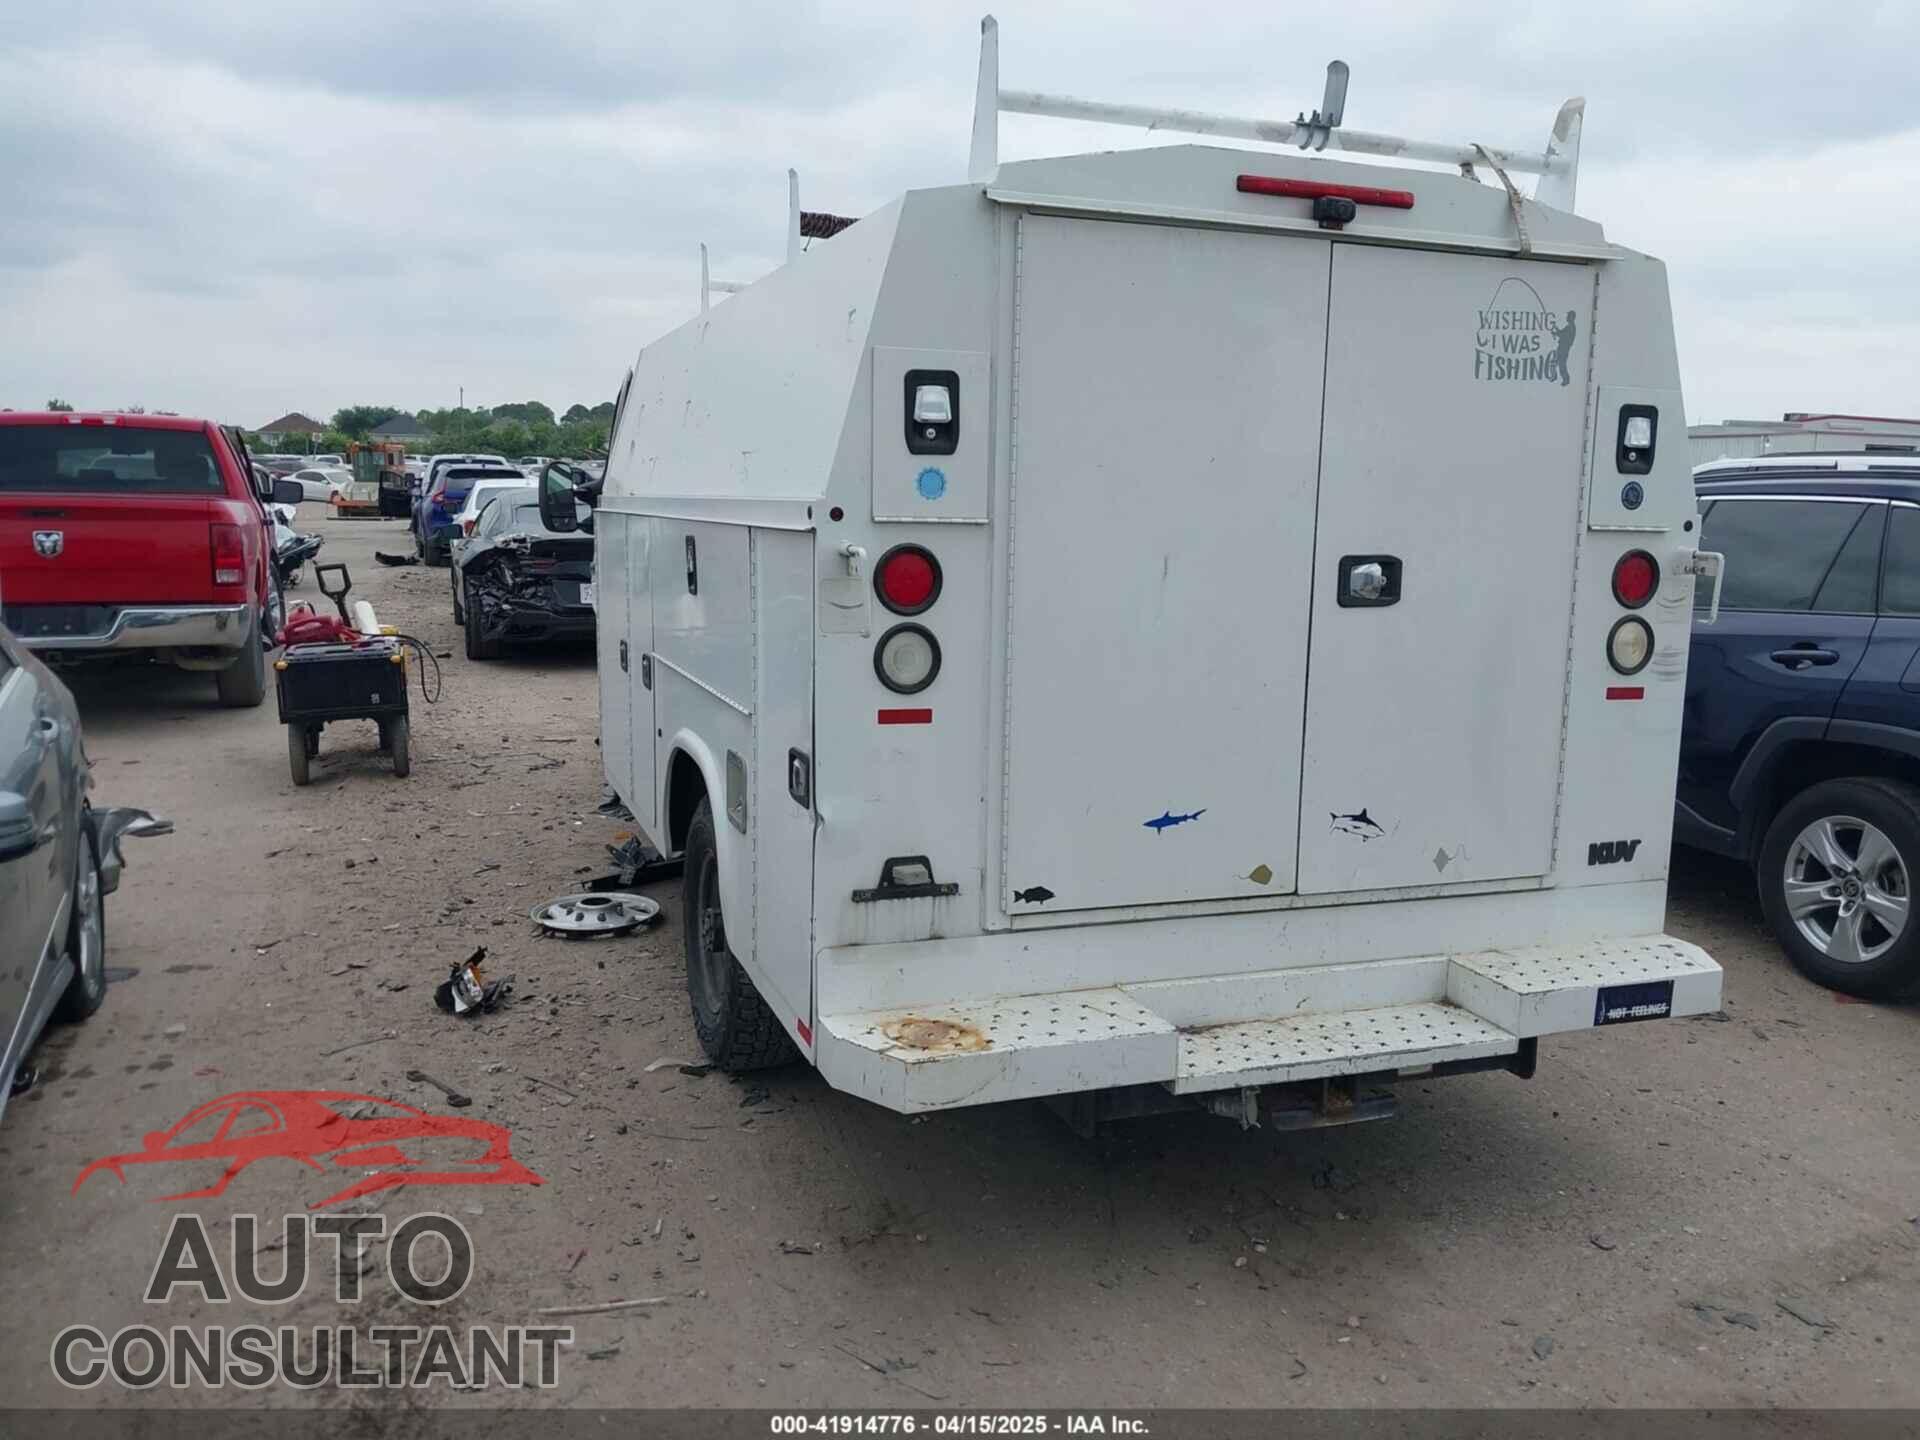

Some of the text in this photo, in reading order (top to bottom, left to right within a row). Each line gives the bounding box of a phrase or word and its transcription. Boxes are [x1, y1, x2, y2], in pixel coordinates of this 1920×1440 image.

[1478, 310, 1557, 331] WISHING
[1502, 334, 1541, 354] WAS
[1474, 347, 1558, 382] FISHING
[1588, 839, 1642, 866] KUV
